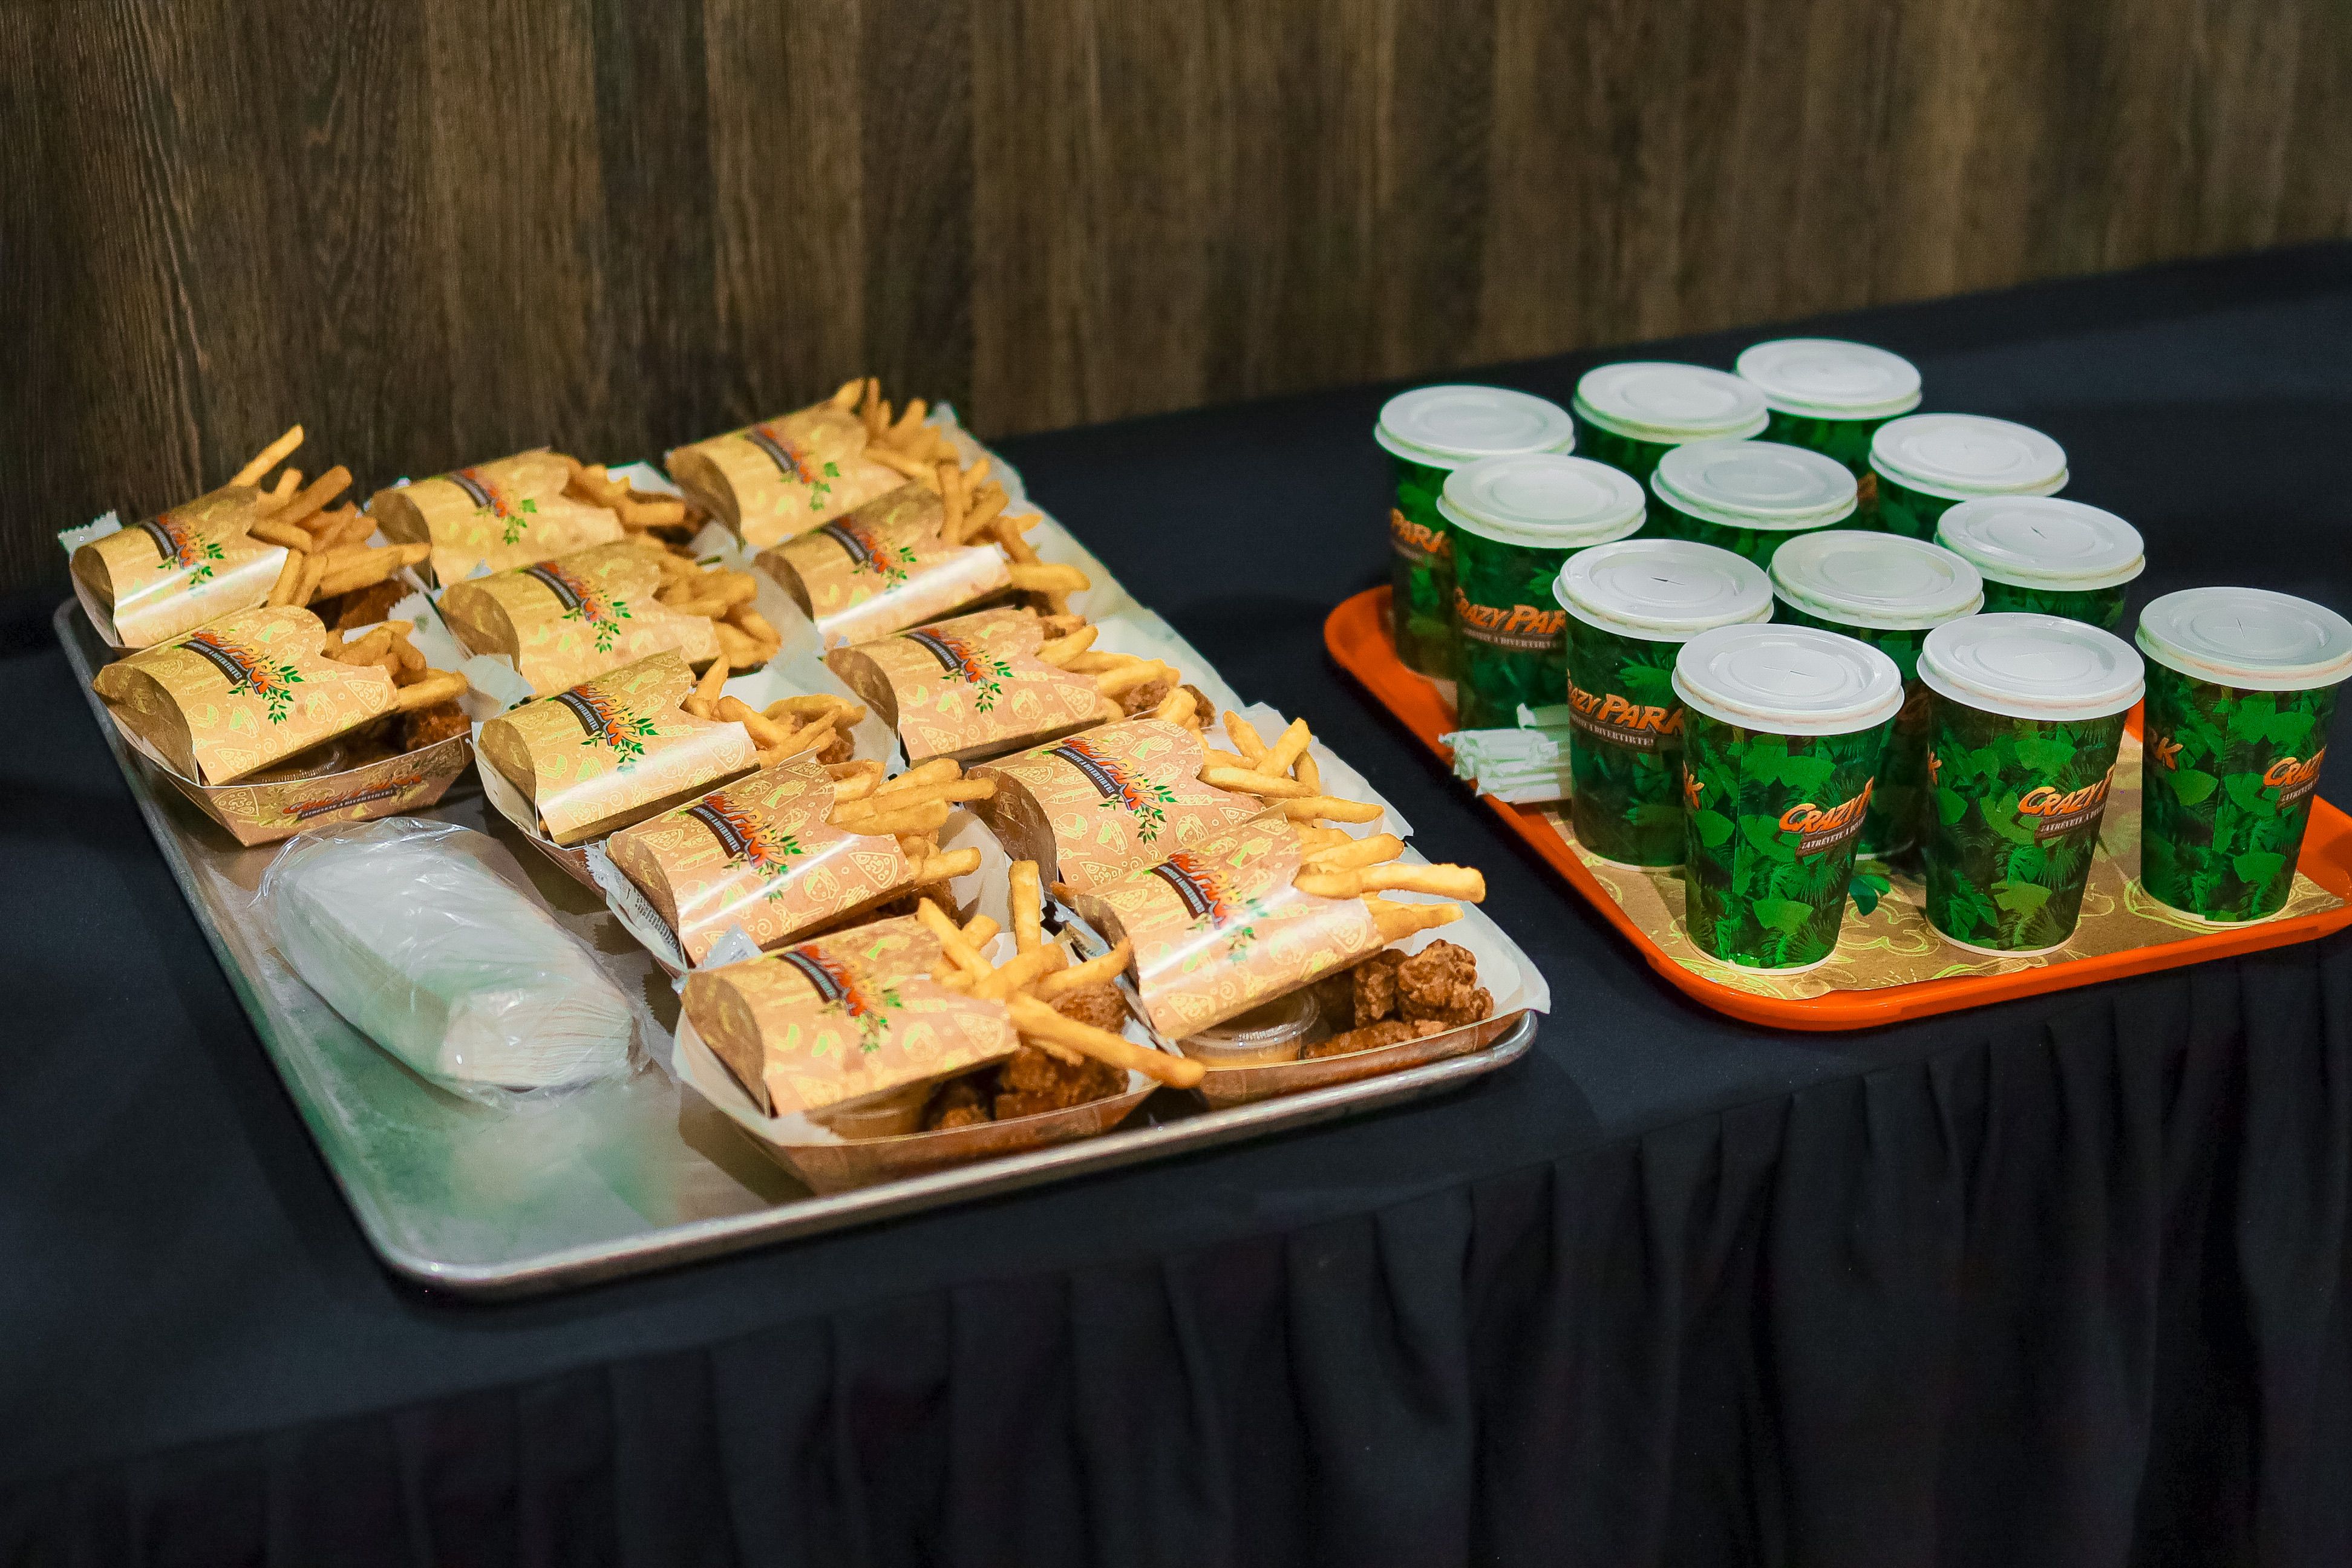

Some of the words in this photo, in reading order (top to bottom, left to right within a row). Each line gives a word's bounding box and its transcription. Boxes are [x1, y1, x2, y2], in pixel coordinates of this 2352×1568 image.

[1097, 759, 1160, 810] PARK
[2018, 780, 2103, 815] CRAZY
[1779, 793, 1863, 833] CRAZY
